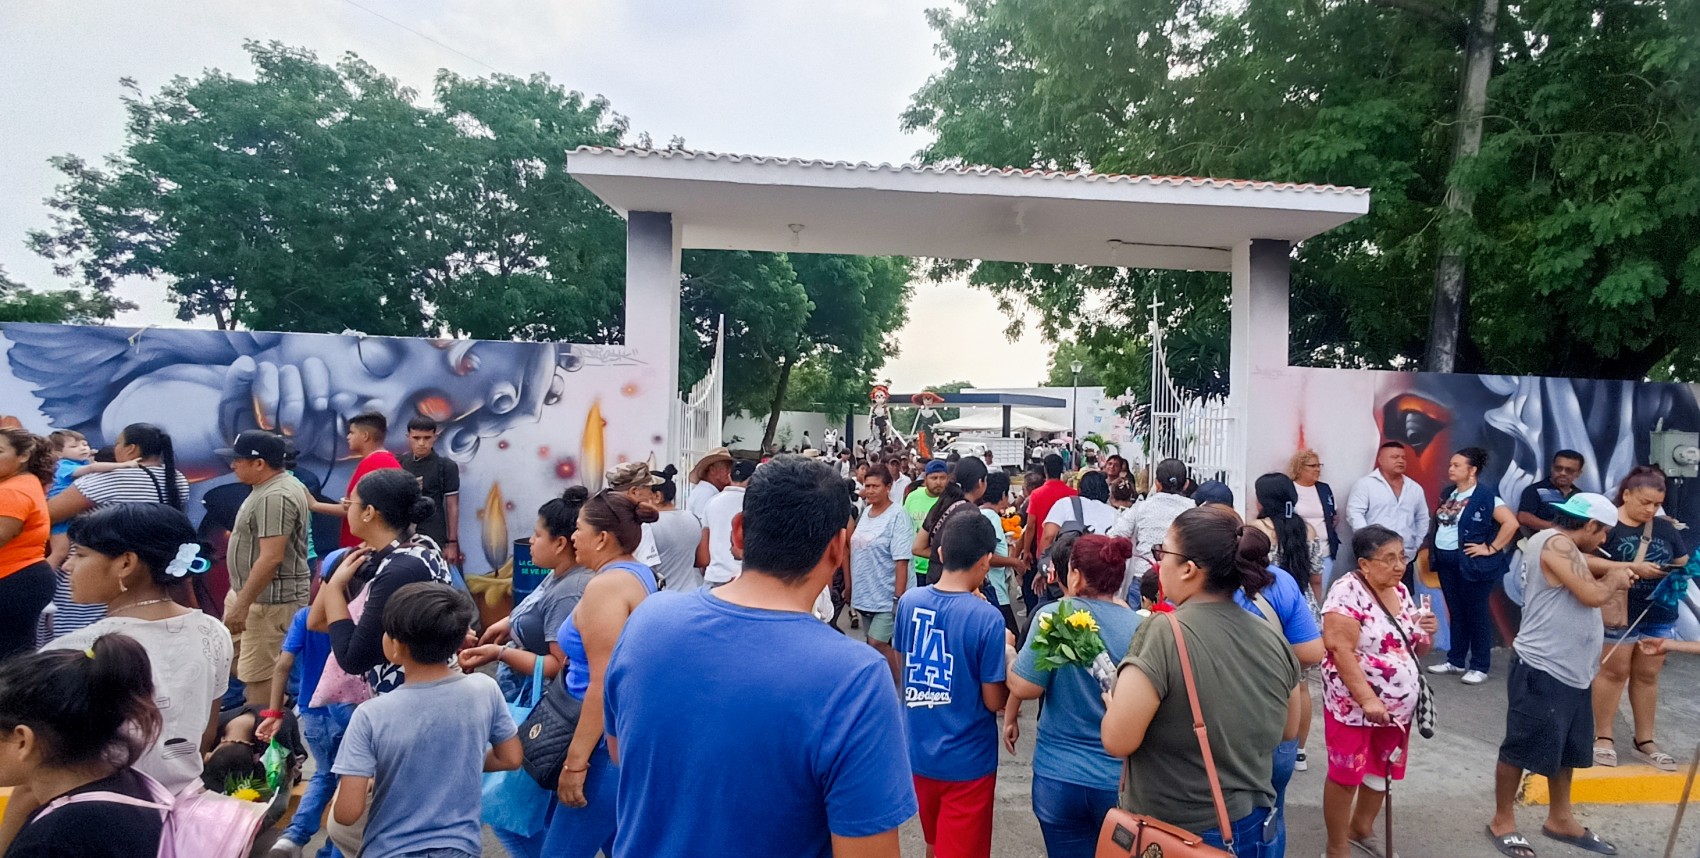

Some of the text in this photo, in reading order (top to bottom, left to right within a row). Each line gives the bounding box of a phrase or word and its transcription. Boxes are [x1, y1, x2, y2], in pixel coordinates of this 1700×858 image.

[906, 607, 954, 691] LA
[905, 686, 953, 708] Dodgers
[1503, 836, 1529, 845] FILA
